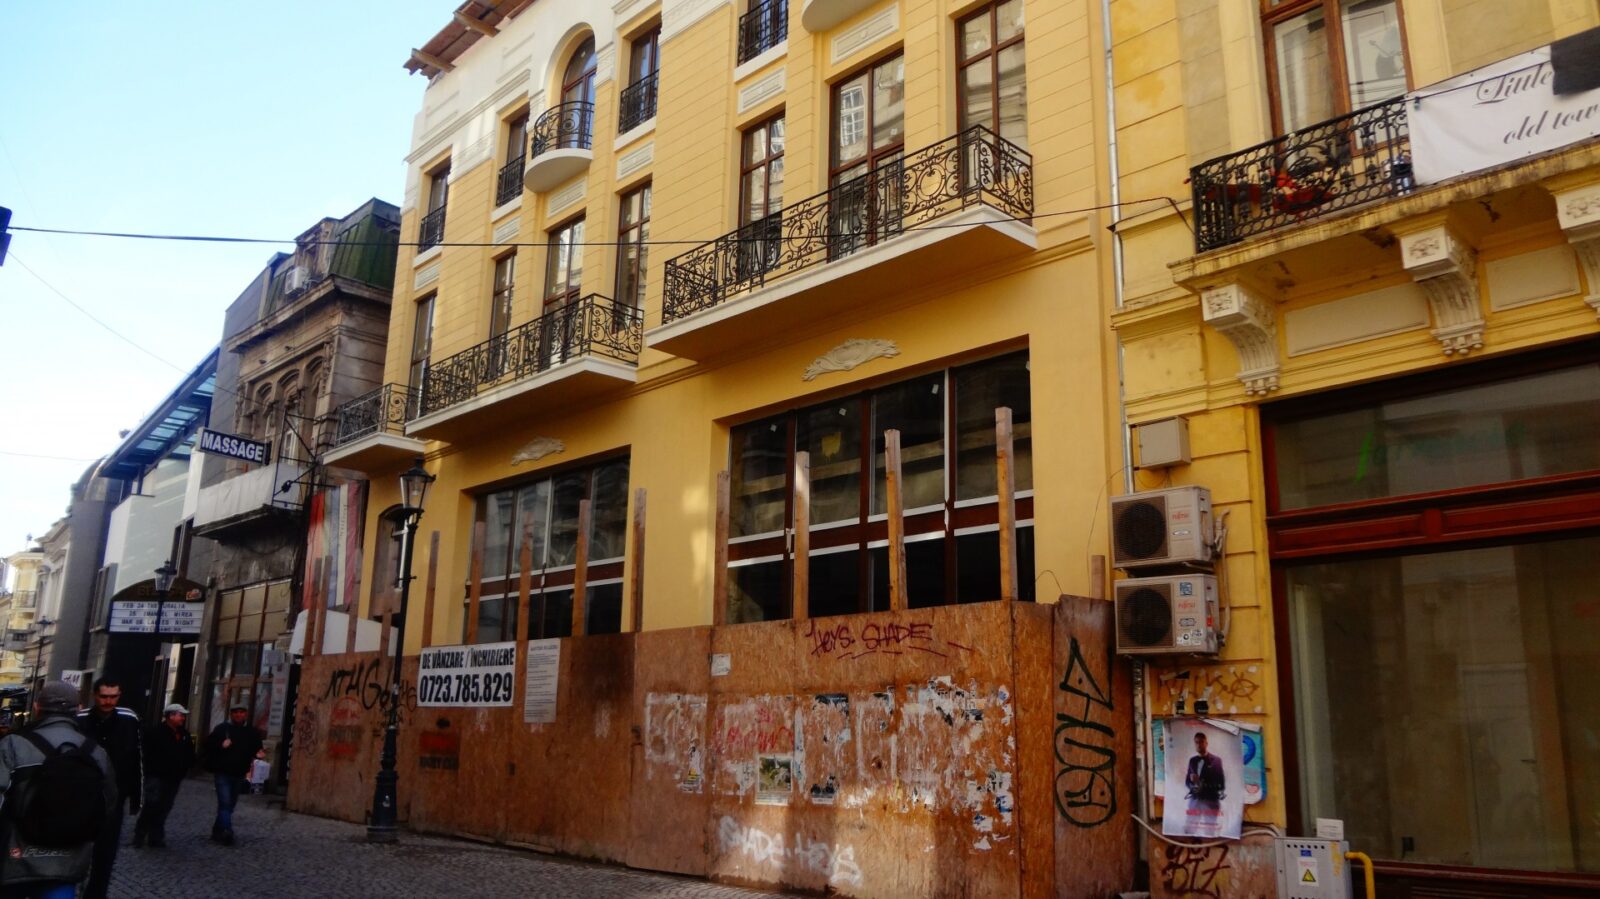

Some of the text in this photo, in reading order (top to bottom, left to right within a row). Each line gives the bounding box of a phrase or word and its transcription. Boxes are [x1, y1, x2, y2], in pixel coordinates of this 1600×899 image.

[1504, 110, 1548, 144] old
[201, 431, 264, 462] MASSAGE
[421, 653, 431, 670] DE
[432, 650, 465, 669] VÂNZARE
[470, 647, 515, 669] ÎNCHIRIERE
[419, 671, 514, 703] 0723.785.829
